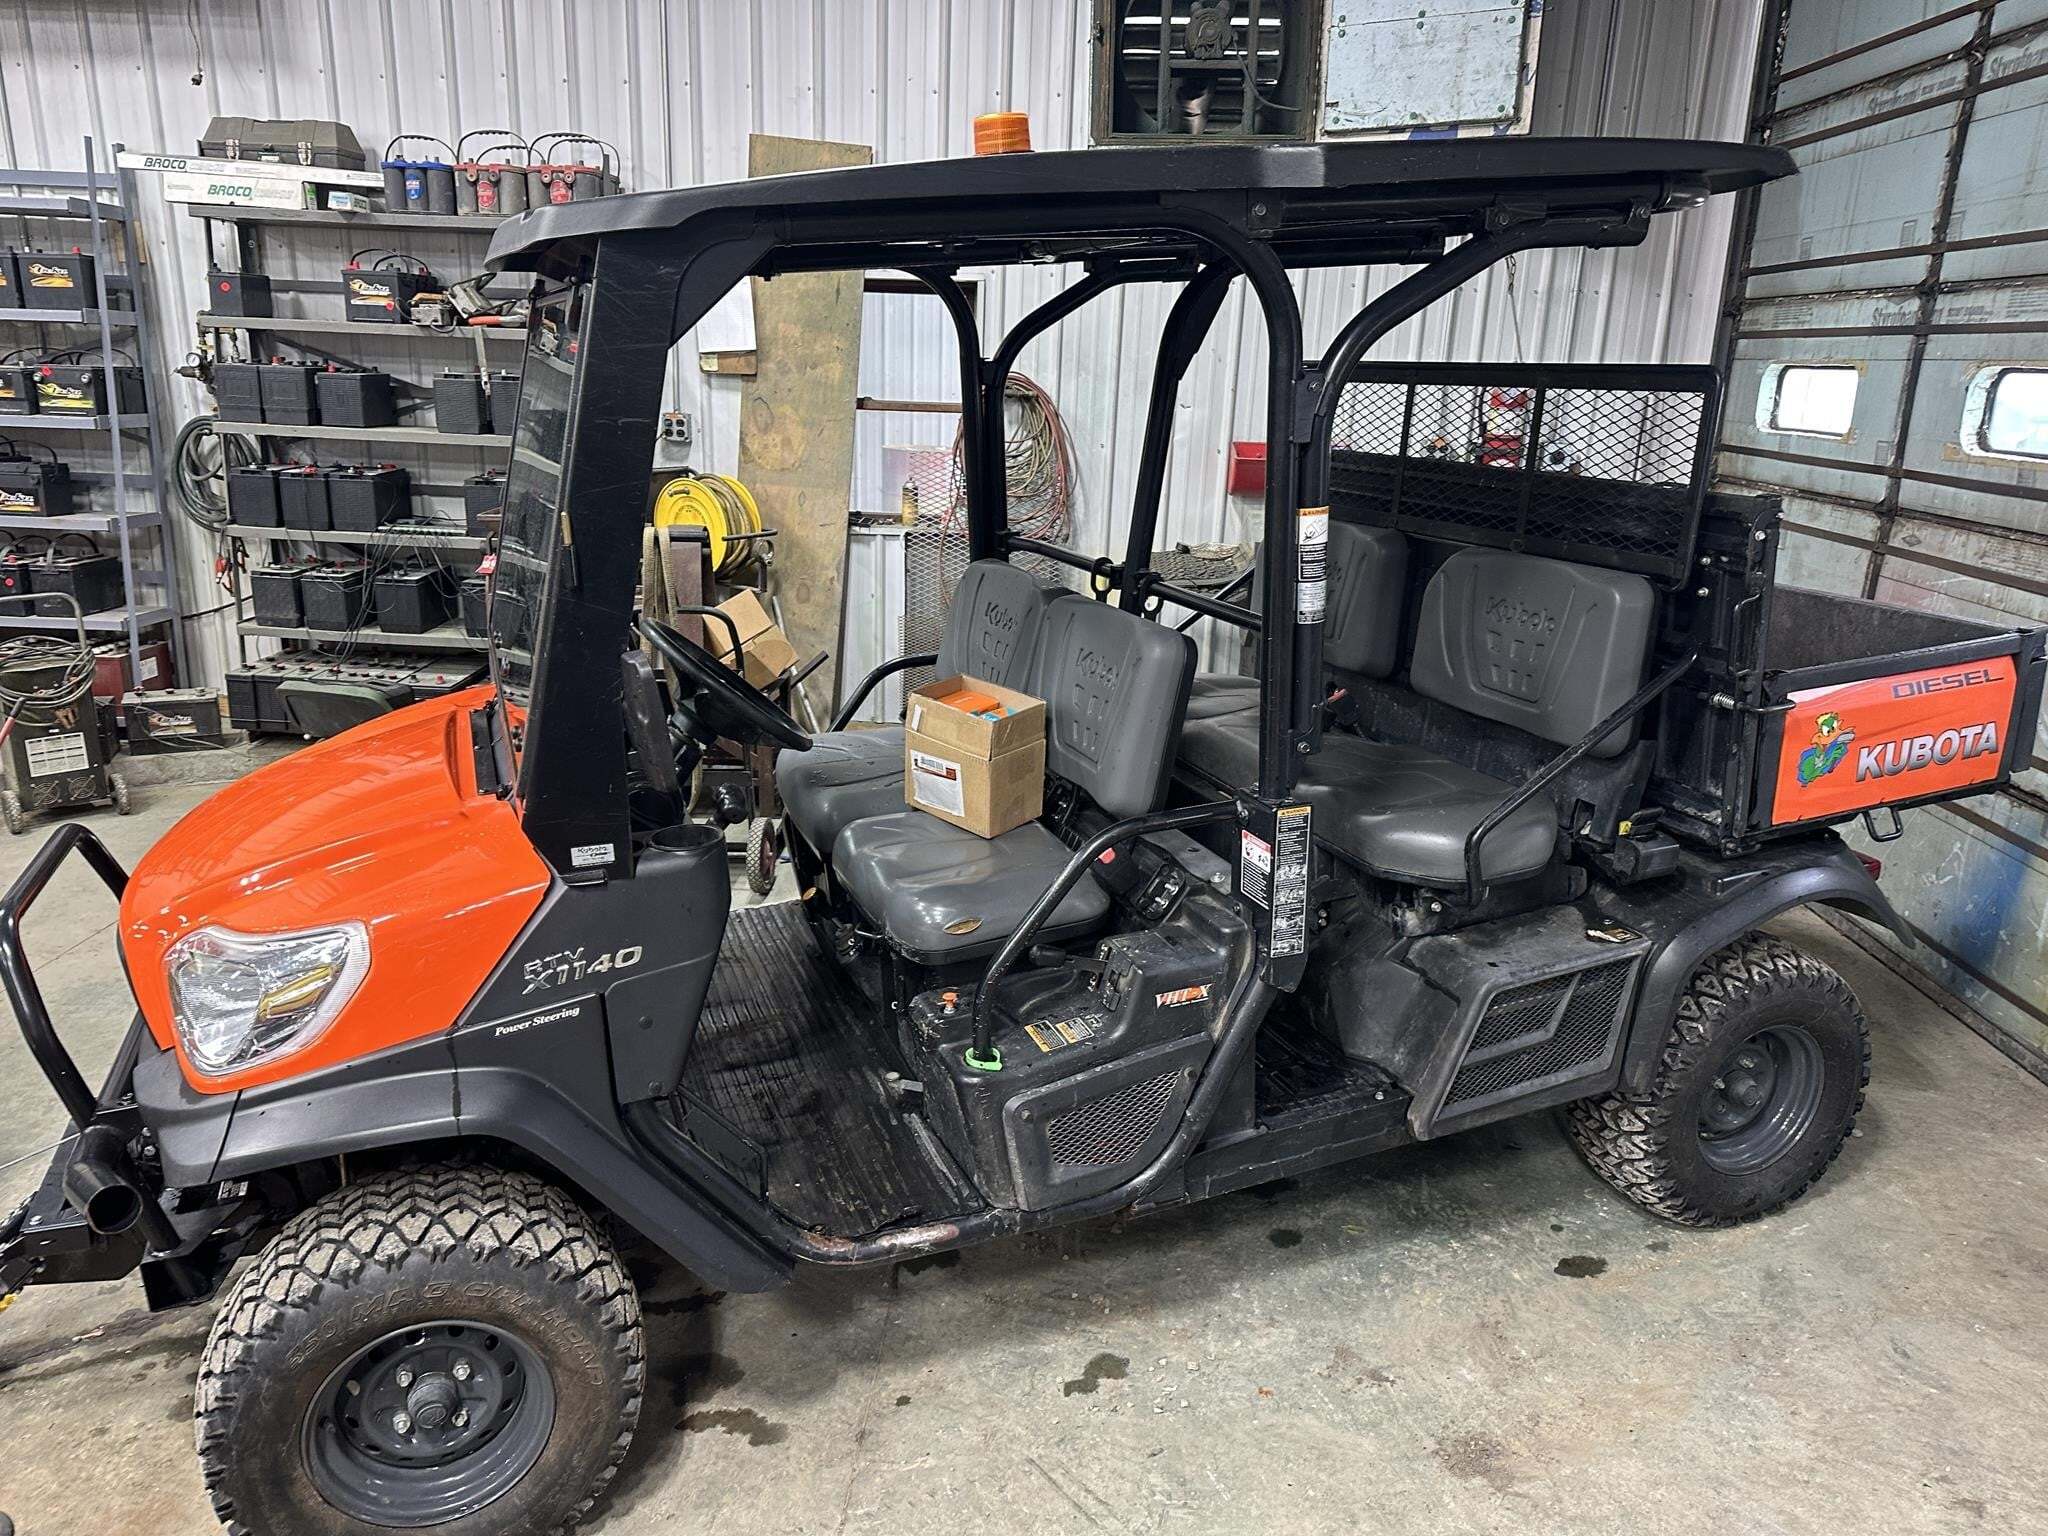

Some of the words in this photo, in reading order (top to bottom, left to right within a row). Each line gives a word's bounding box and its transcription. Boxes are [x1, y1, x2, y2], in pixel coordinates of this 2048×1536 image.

[144, 157, 187, 170] BROCO
[207, 184, 252, 197] BROCO
[1891, 669, 2004, 698] DIESEL
[1855, 722, 1998, 782] KUBOTA
[522, 946, 642, 994] X1140
[523, 947, 584, 977] RTV
[495, 1021, 532, 1036] Power
[532, 1007, 580, 1026] Steering
